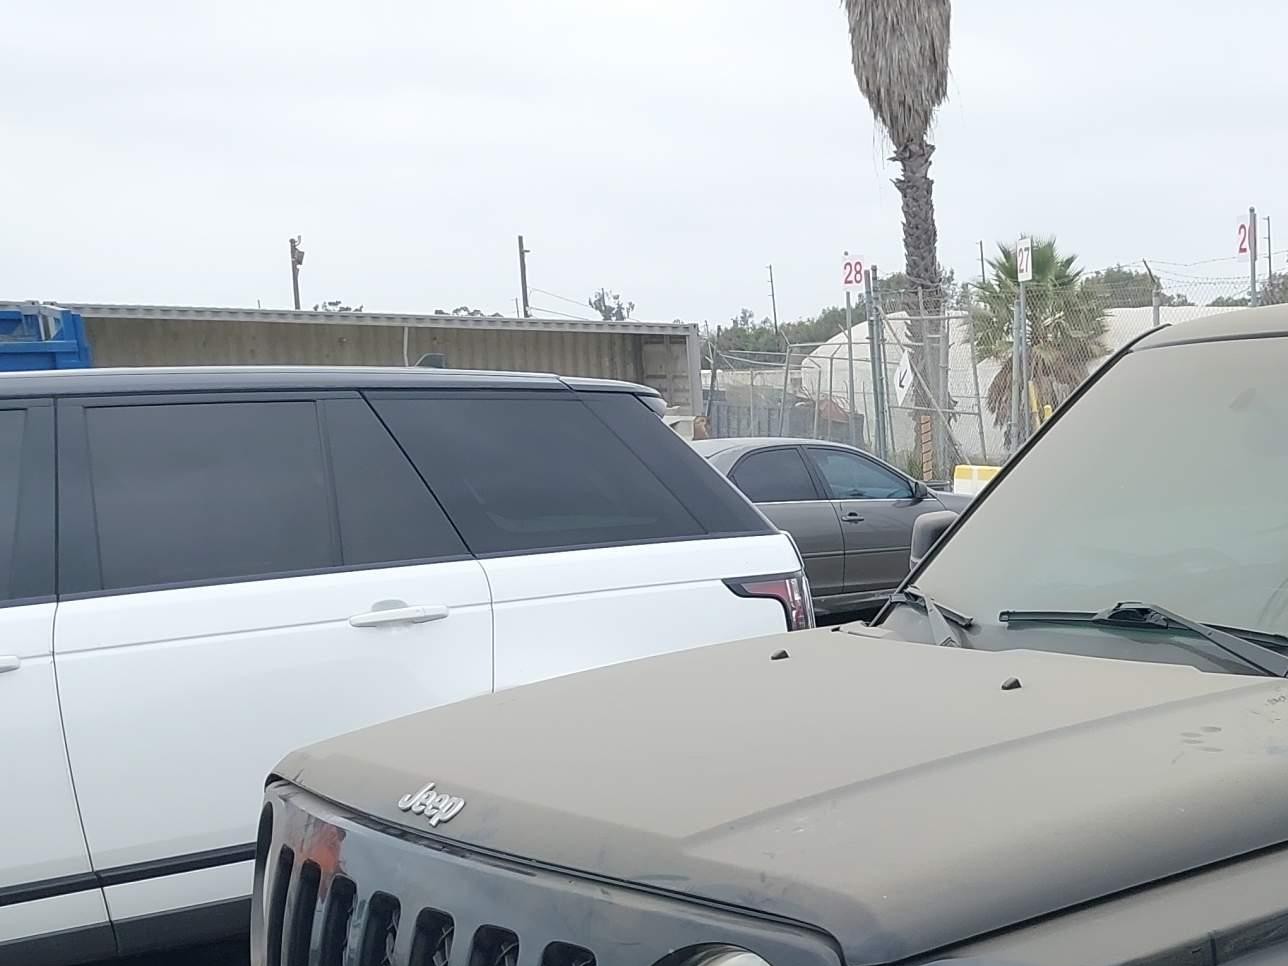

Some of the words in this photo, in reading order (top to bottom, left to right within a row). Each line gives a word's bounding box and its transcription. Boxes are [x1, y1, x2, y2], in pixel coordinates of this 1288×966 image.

[1238, 223, 1251, 253] 2
[843, 261, 863, 285] 28
[1018, 246, 1030, 273] 27
[398, 782, 465, 827] Jeep
